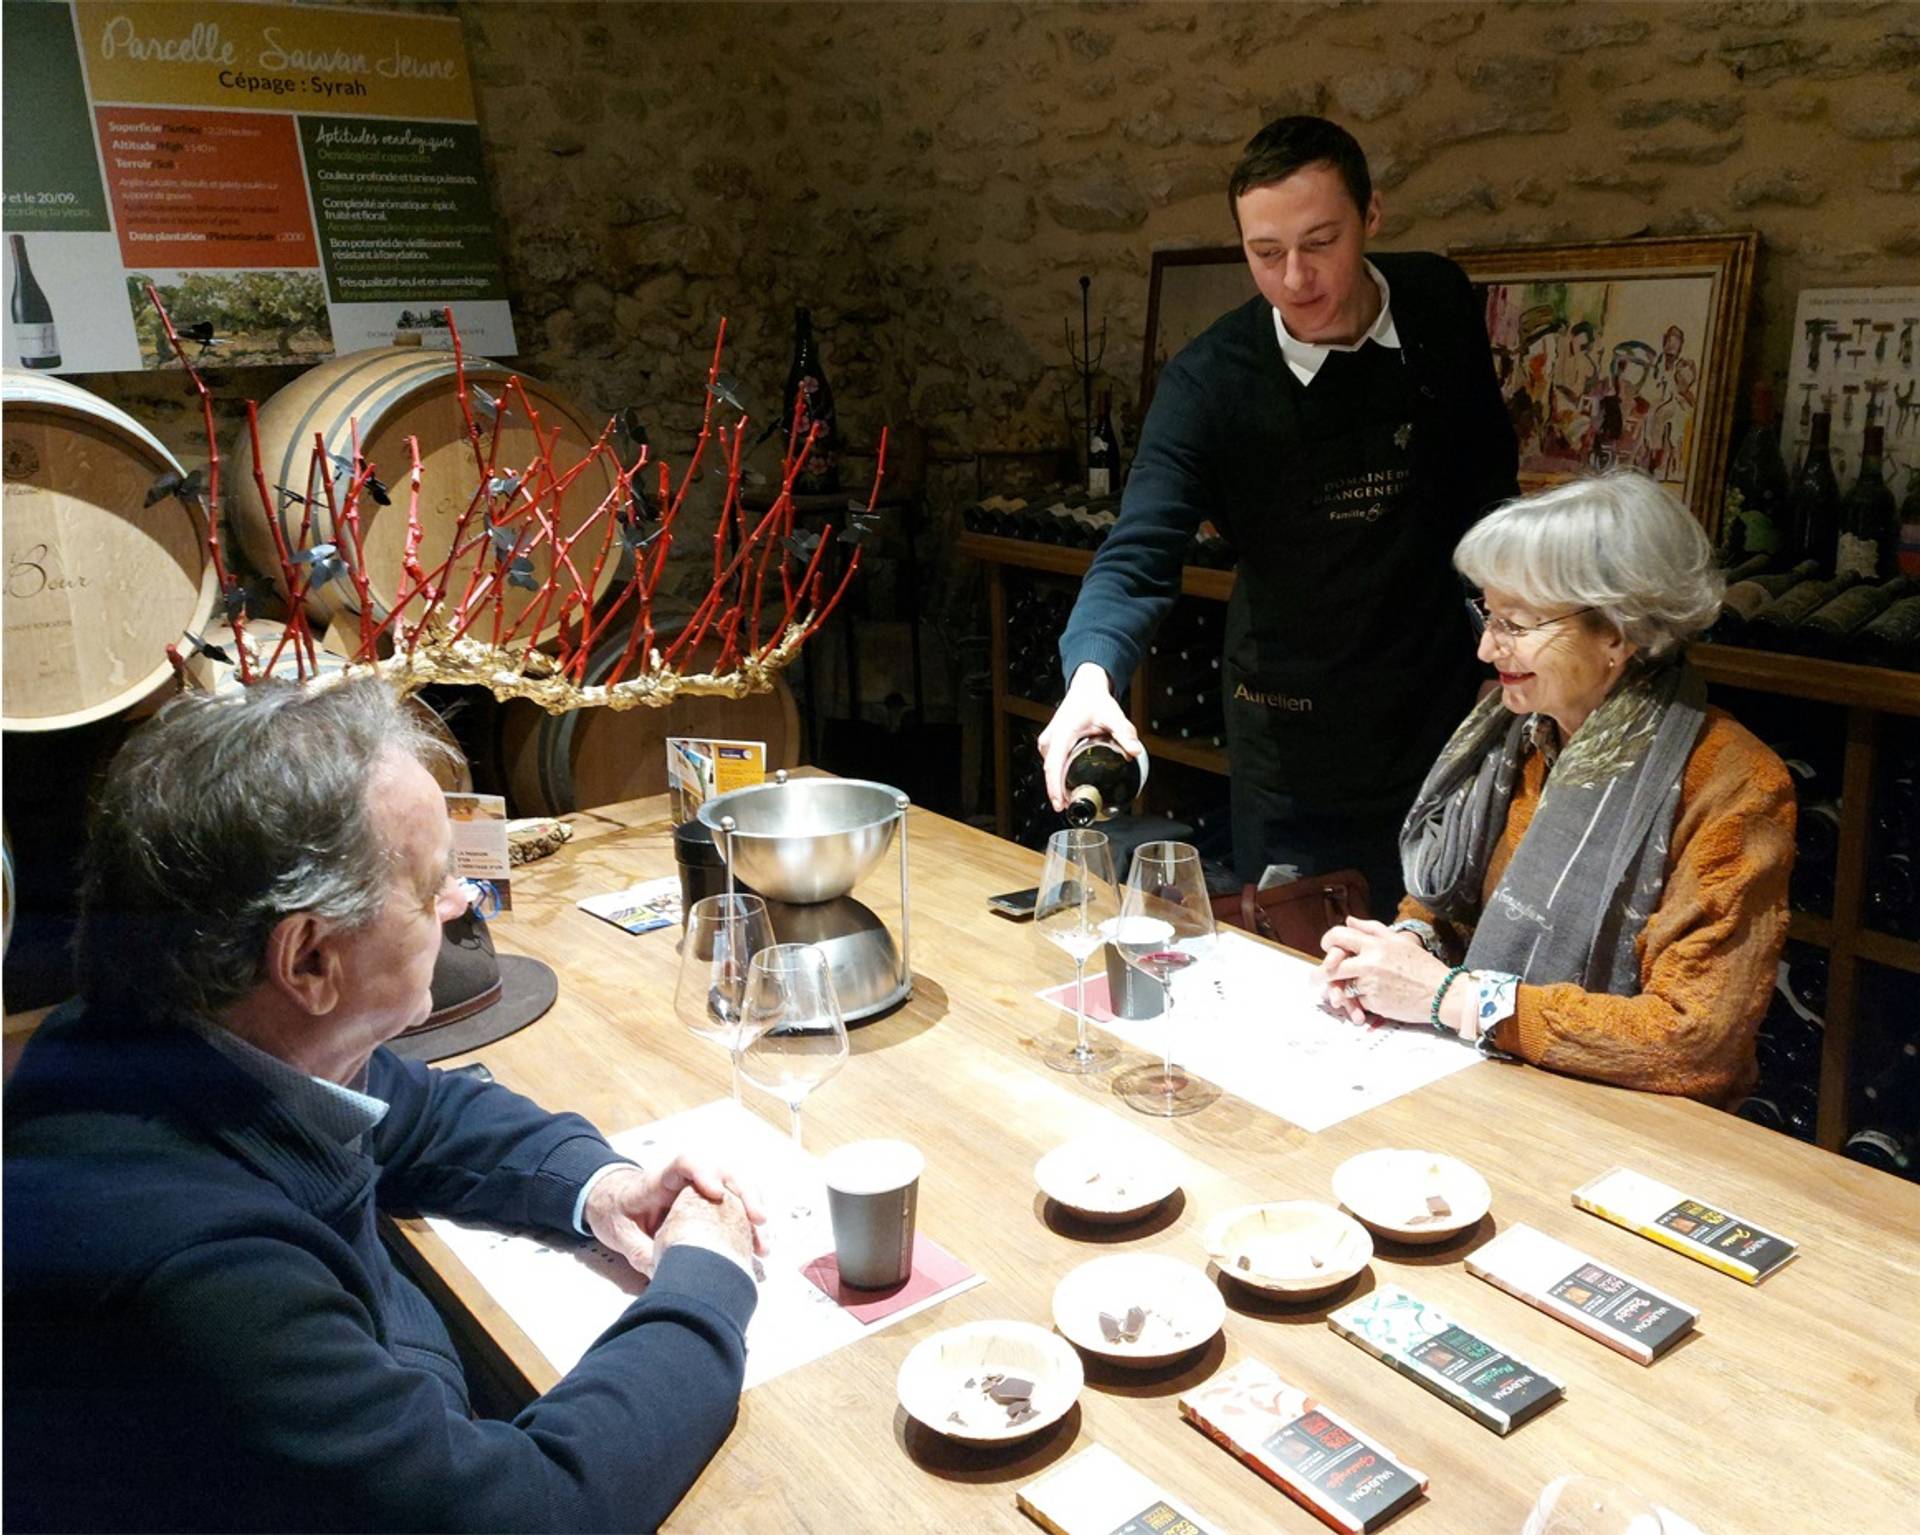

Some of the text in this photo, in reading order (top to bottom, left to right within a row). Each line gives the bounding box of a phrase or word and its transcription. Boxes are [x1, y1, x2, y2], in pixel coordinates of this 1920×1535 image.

[102, 16, 238, 66] Parcelle
[258, 26, 371, 76] Sauvan
[375, 38, 460, 81] Jeune
[218, 70, 296, 95] Cépage
[309, 77, 368, 97] Syrah
[108, 121, 163, 134] Superficie
[315, 123, 380, 147] Aptitudes
[112, 140, 157, 151] Altitude
[115, 158, 152, 169] Terroir
[317, 169, 356, 181] Couleur
[9, 191, 22, 203] et
[23, 191, 36, 204] le
[37, 191, 79, 205] 20/09.
[129, 230, 155, 242] Date
[155, 230, 206, 243] plantation
[329, 238, 351, 249] Bon
[1330, 508, 1366, 521] Famille
[1632, 1306, 1670, 1333] VALRHONA
[1491, 1374, 1535, 1400] VALRHONA
[1346, 1469, 1396, 1503] VALRHONA
